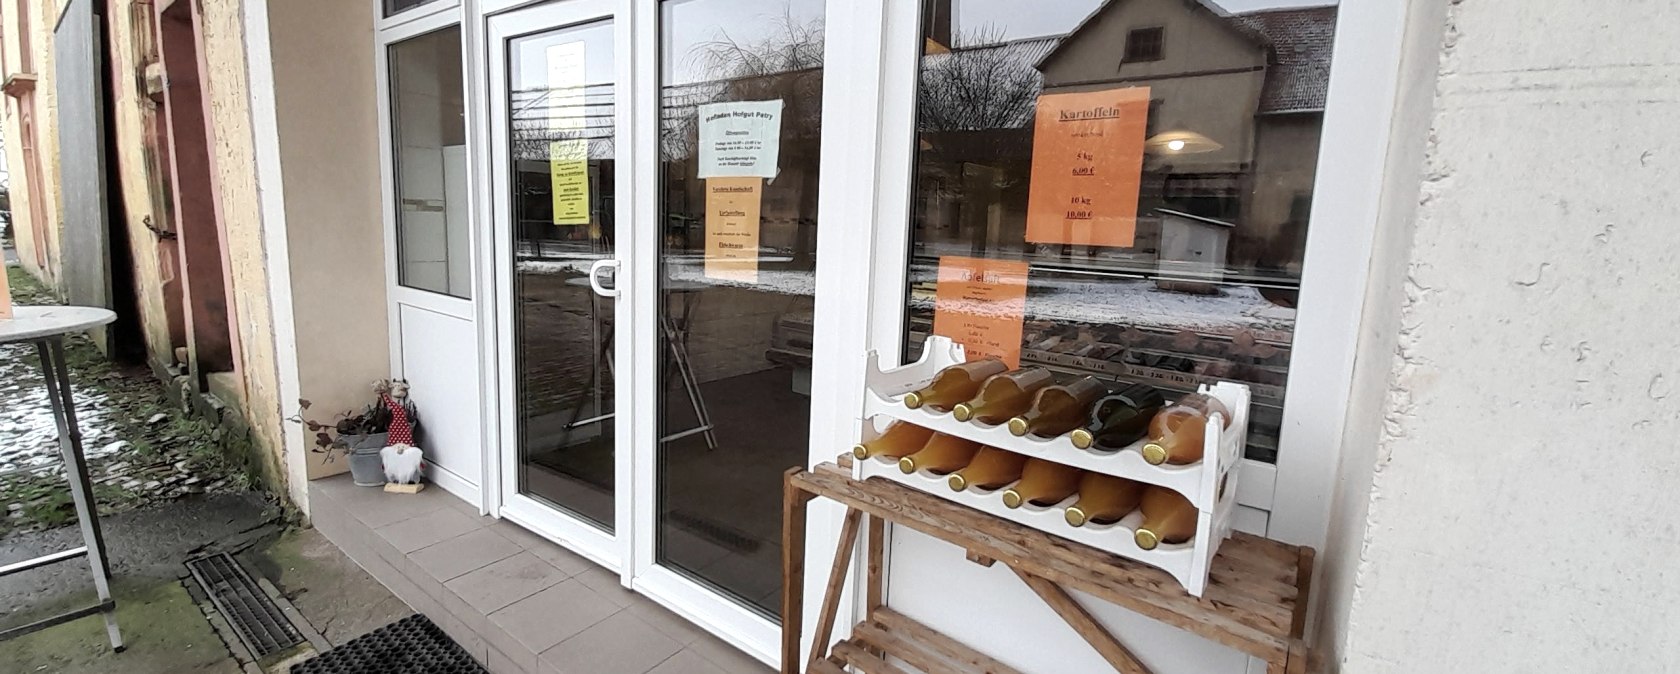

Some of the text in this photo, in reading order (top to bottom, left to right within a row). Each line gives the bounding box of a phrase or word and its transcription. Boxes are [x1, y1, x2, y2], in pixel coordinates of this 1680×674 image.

[733, 111, 754, 119] Hofgut
[756, 112, 773, 121] Petry
[1059, 107, 1120, 121] Kartoffeln
[1083, 152, 1093, 161] kg
[1072, 167, 1088, 175] 6,00
[1081, 196, 1091, 205] kg
[1066, 211, 1087, 219] 10,00
